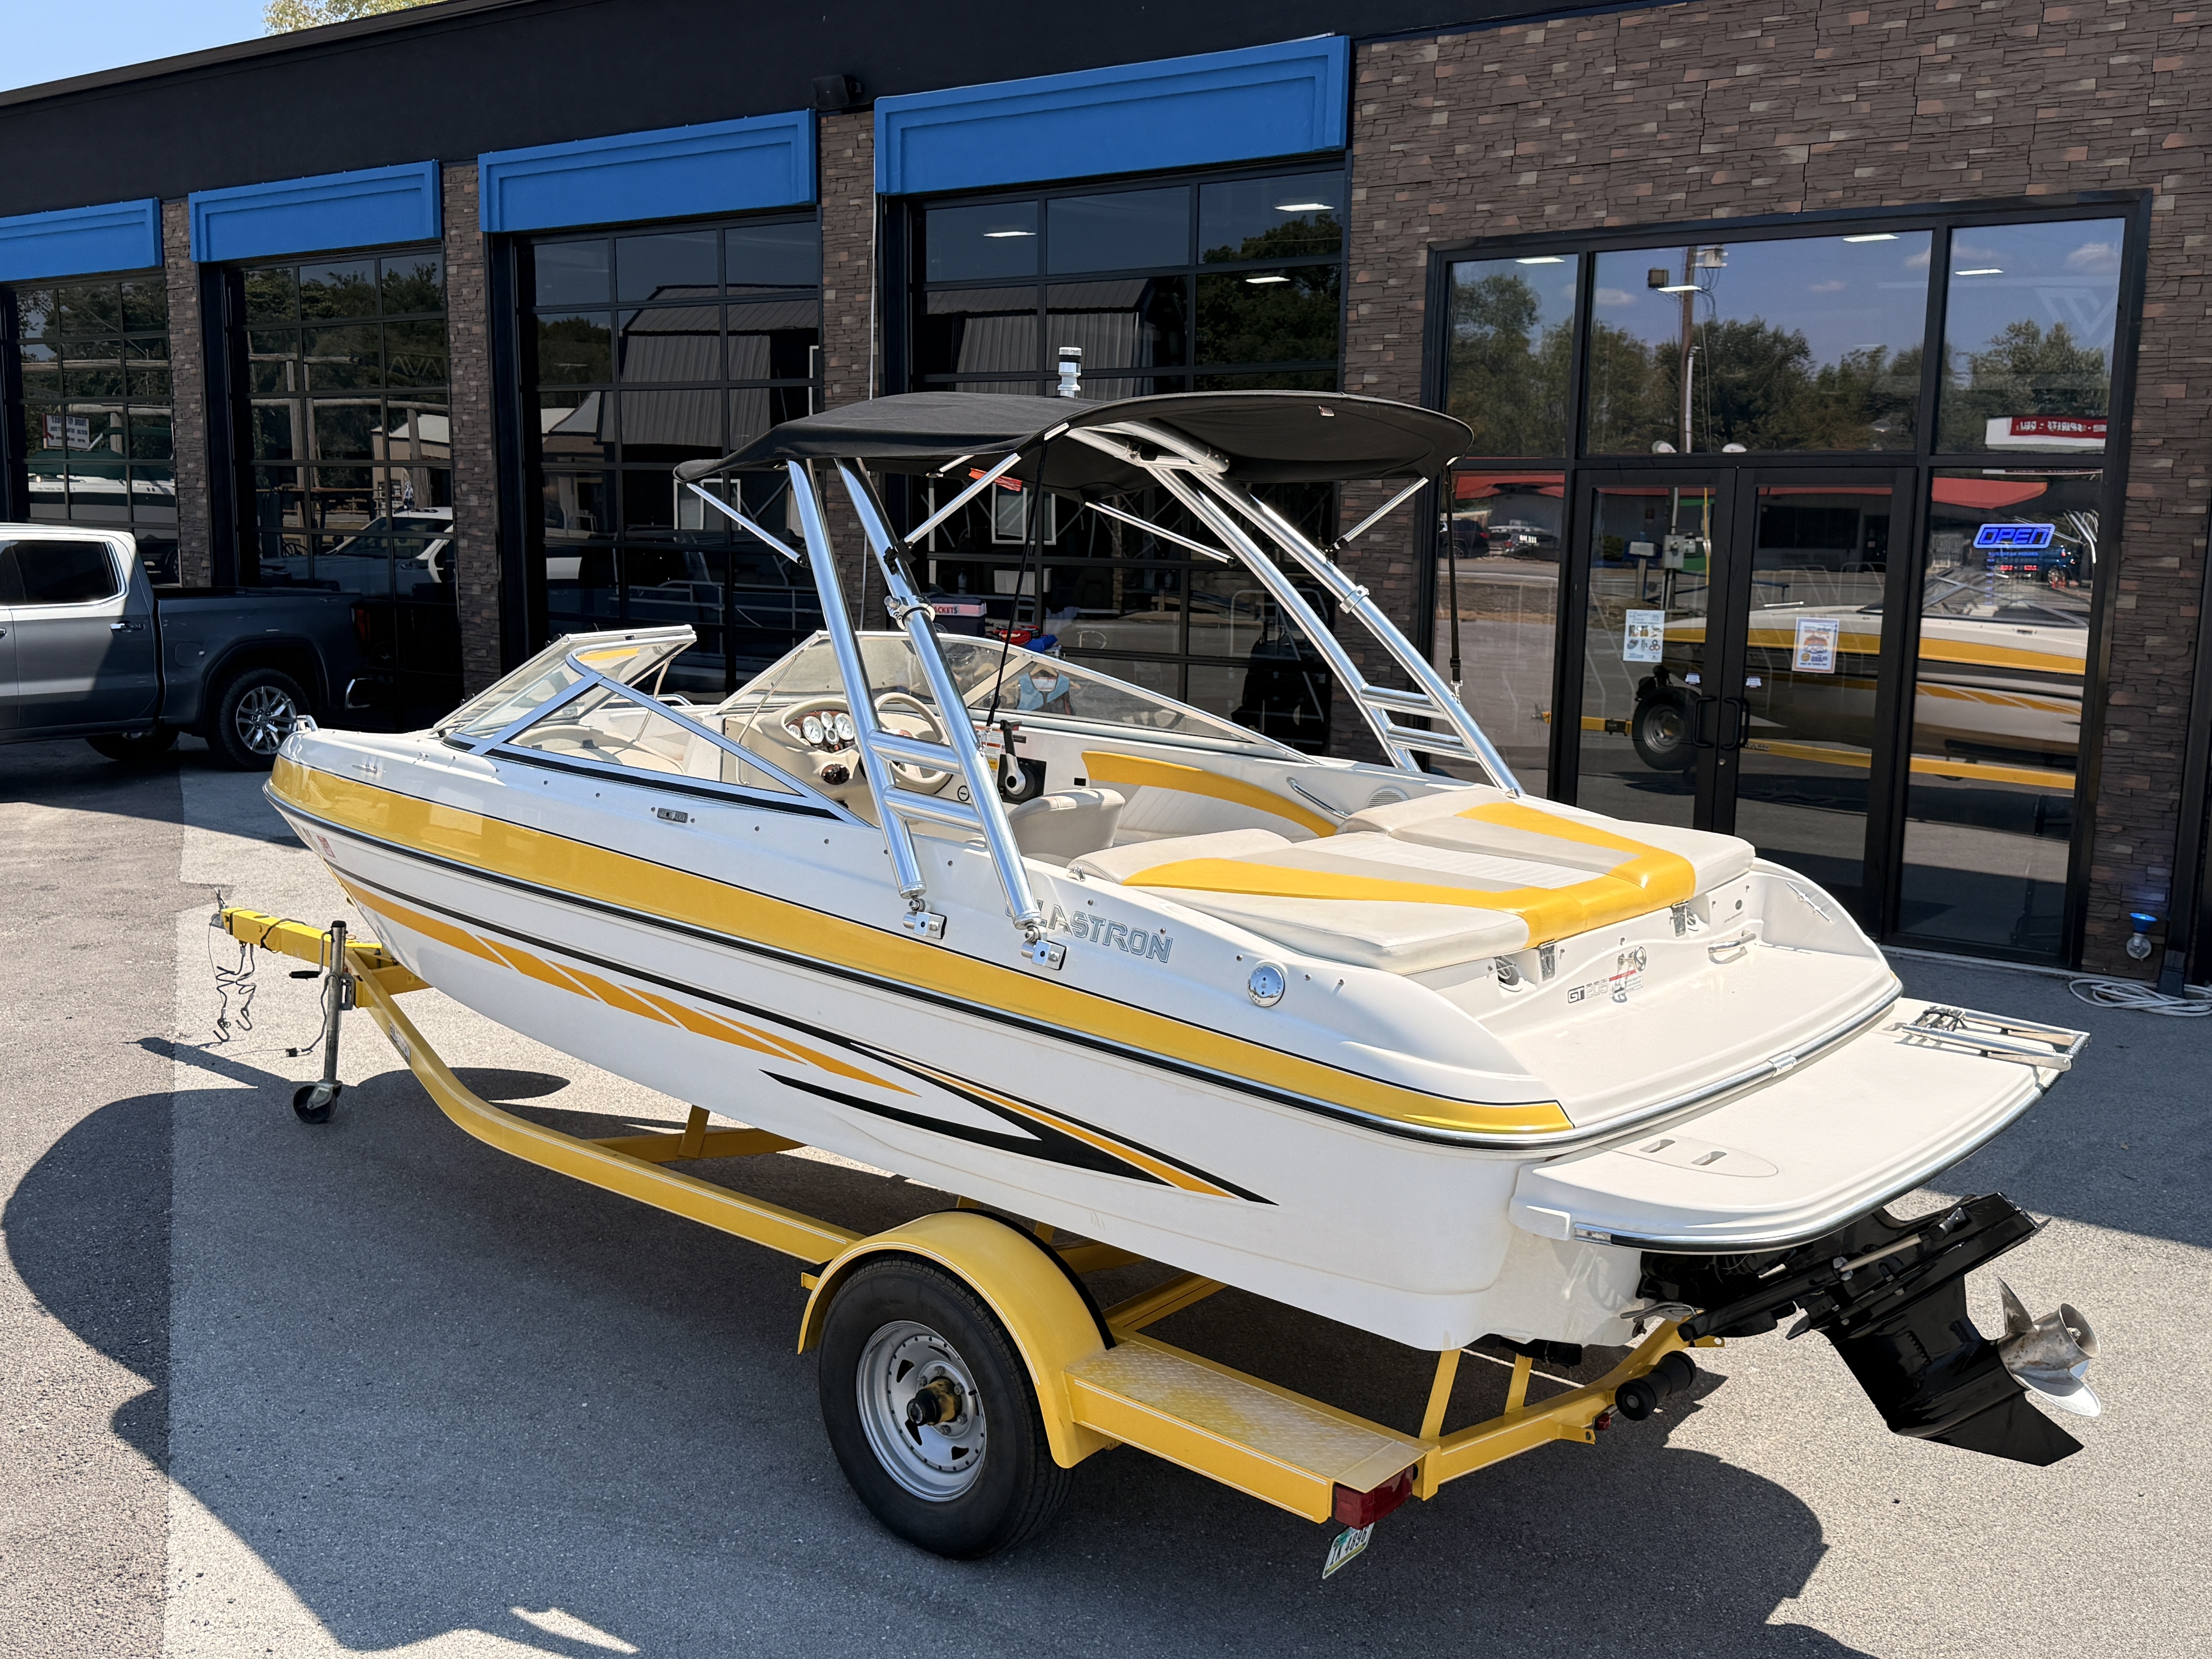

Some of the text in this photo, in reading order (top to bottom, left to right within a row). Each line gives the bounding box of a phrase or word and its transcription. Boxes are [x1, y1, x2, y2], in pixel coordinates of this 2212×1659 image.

[1979, 529, 2049, 544] OPEN
[1568, 987, 1584, 1003] GT
[1586, 978, 1608, 999] 205
